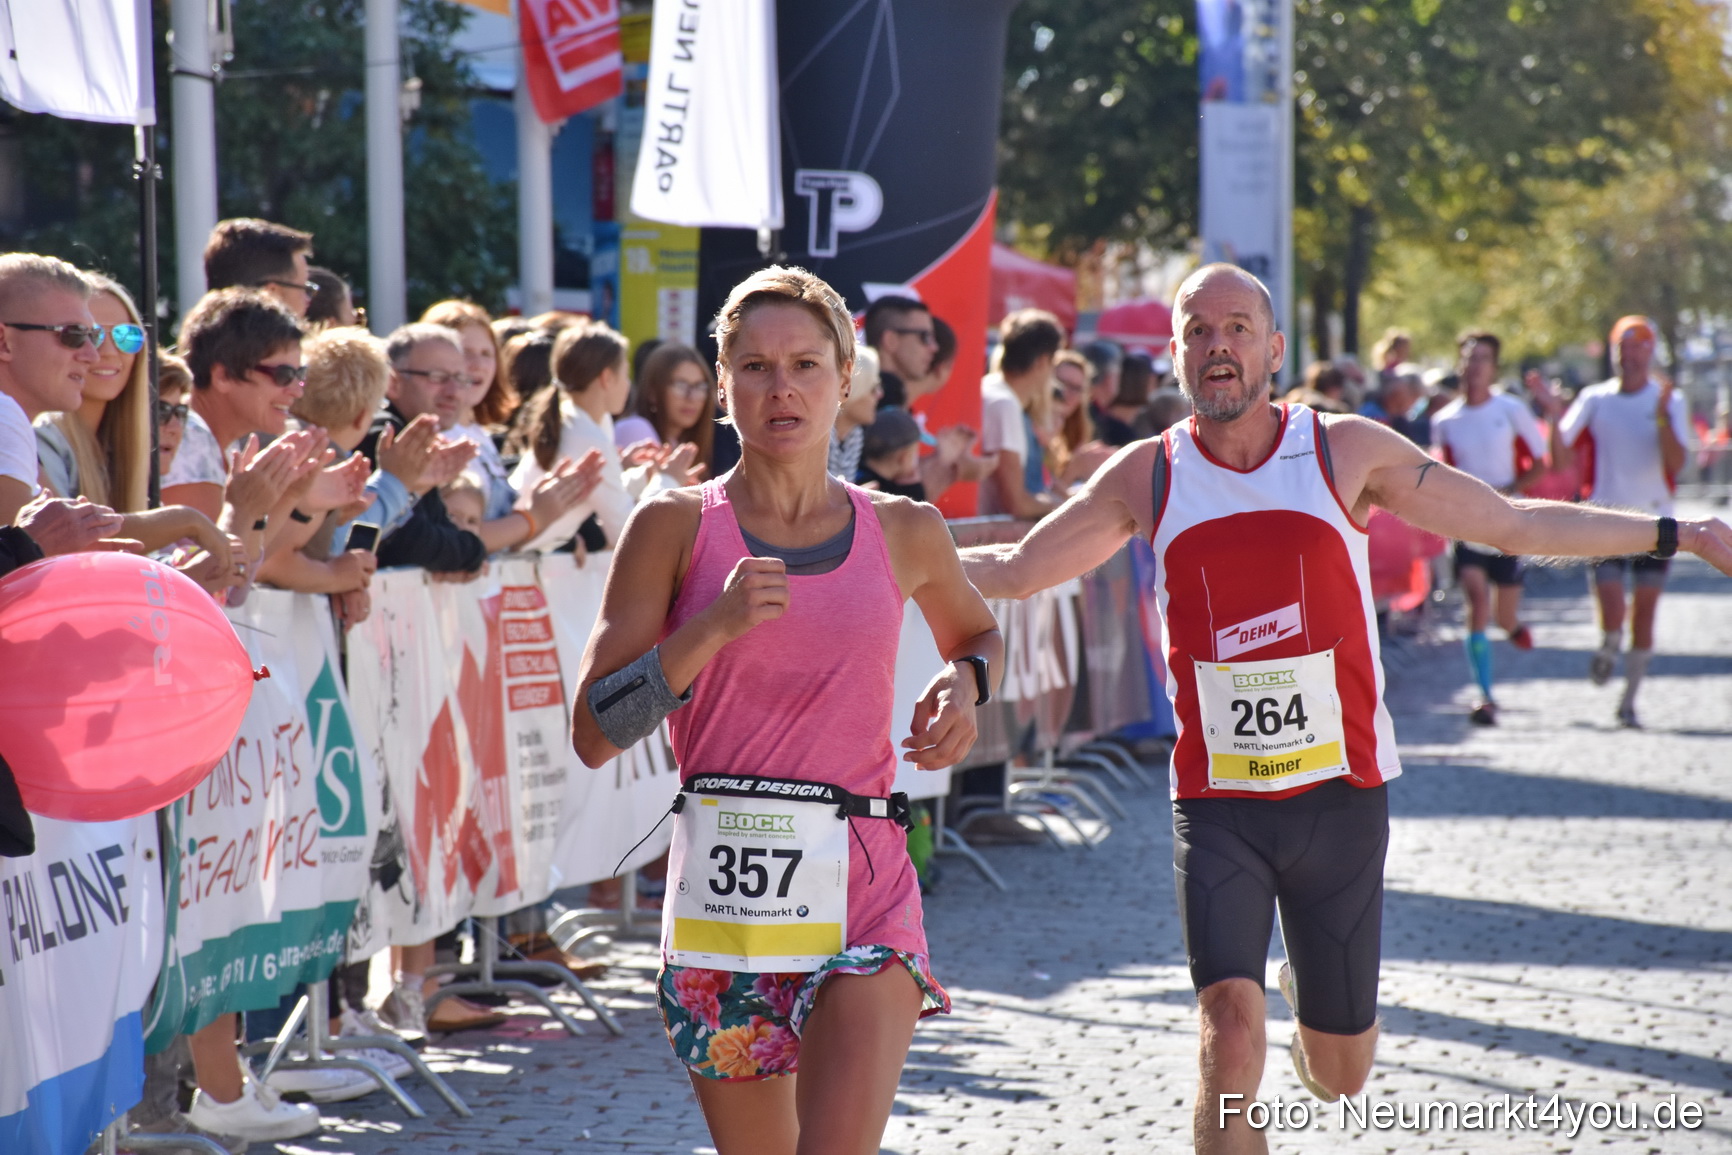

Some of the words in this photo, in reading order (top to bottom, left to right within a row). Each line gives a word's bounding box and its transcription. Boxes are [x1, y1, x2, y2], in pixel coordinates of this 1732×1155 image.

[1239, 620, 1278, 645] DEHN
[1232, 670, 1296, 688] BOCK
[1231, 693, 1309, 736] 264
[1210, 727, 1216, 736] B
[1233, 742, 1261, 751] PARTL
[1261, 739, 1303, 751] Neumarkt
[1249, 758, 1302, 777] Rainer
[693, 777, 754, 792] PROFILE
[755, 780, 825, 797] DESIGN
[718, 811, 796, 833] BOCK
[708, 844, 803, 898] 357
[679, 881, 686, 891] C
[704, 903, 738, 916] PARTL
[740, 905, 793, 918] Neumarkt
